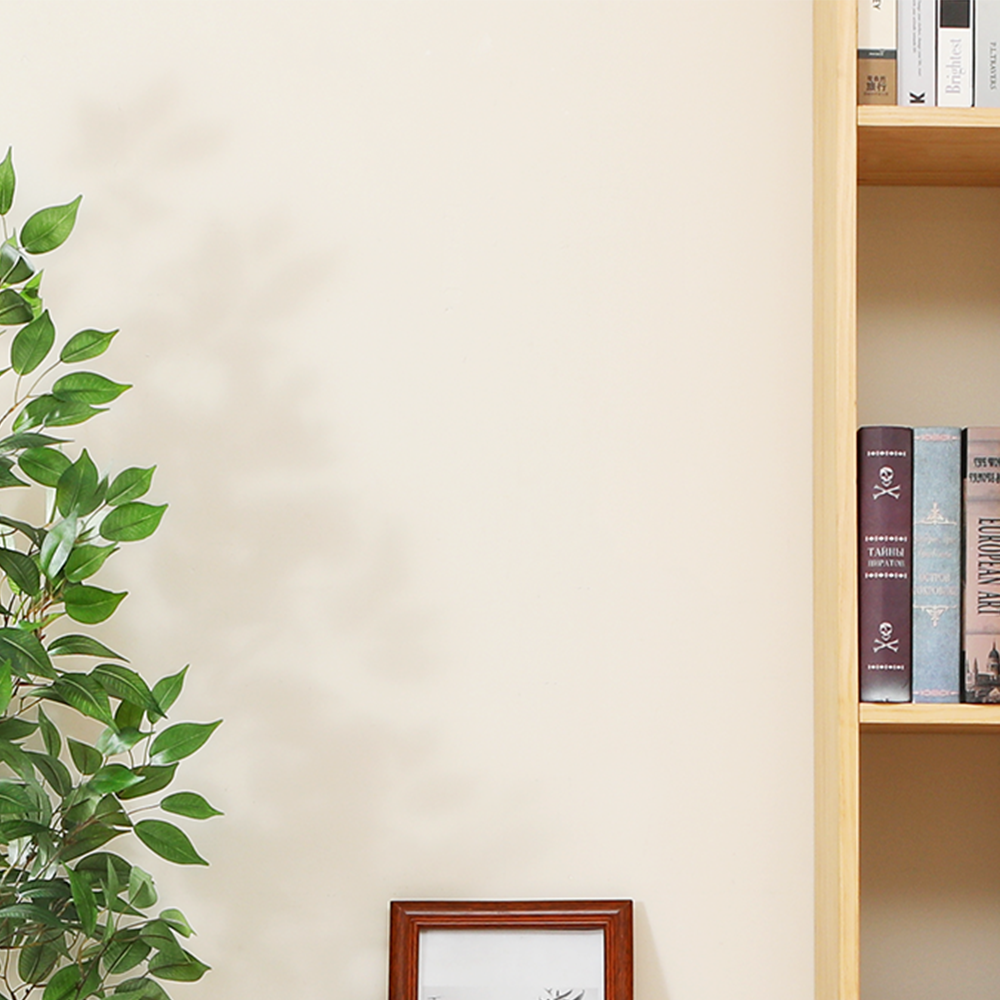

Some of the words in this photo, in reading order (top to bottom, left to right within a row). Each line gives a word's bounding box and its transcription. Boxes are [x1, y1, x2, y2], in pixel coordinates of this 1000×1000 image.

[945, 39, 966, 94] Brightest
[910, 92, 925, 104] K
[977, 518, 1000, 584] EUROPEAN
